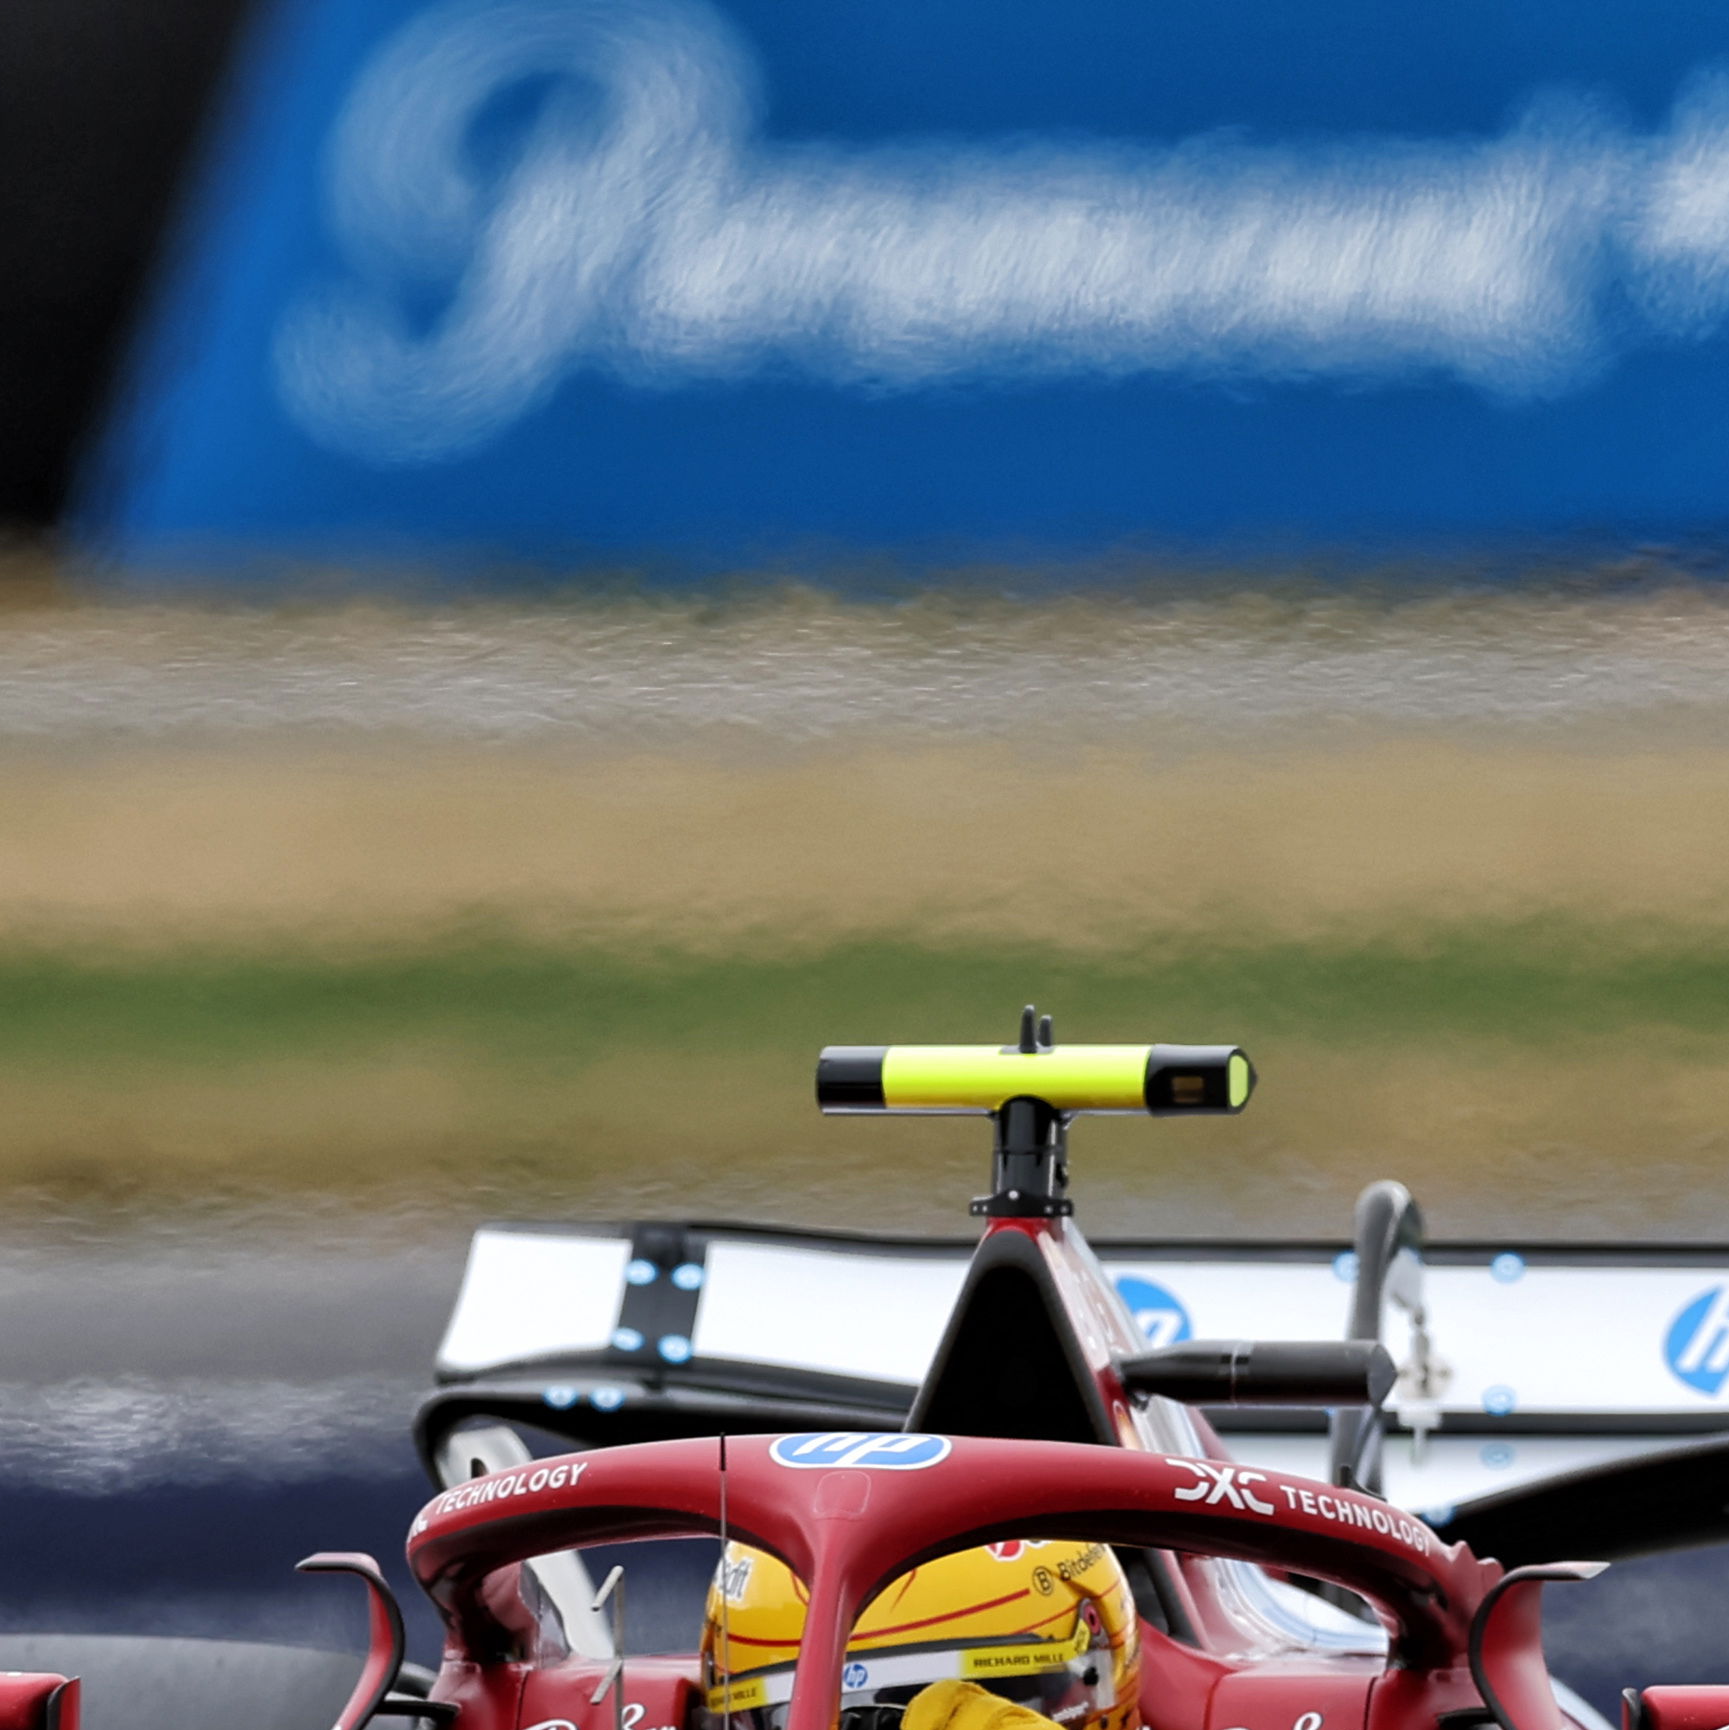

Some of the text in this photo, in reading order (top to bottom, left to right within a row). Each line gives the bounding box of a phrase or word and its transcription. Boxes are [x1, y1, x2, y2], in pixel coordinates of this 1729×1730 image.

[435, 1461, 589, 1515] TECHNOLOGY
[1033, 1653, 1065, 1665] MILLE
[844, 1664, 868, 1688] hp
